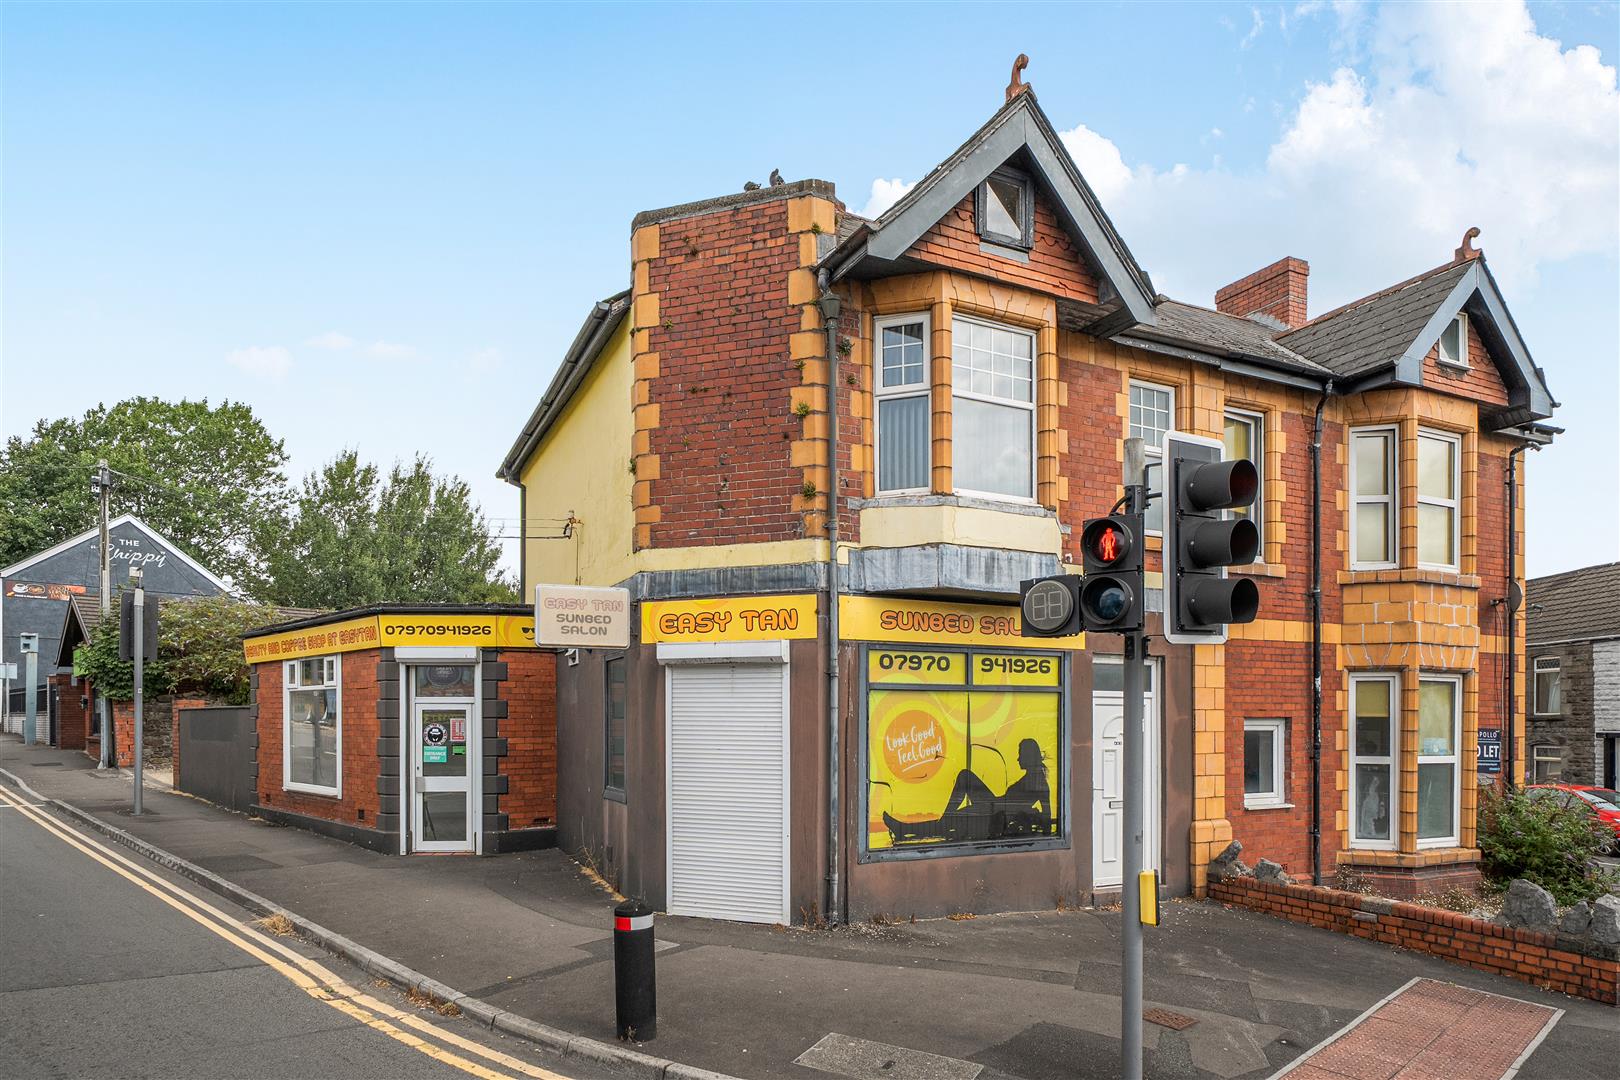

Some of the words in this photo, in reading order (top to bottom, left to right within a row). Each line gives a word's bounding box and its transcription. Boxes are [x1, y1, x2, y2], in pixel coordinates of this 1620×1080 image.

[544, 597, 588, 611] EASY
[591, 599, 625, 613] TAN
[556, 613, 612, 625] SUNBED
[659, 611, 732, 634] EASY
[740, 608, 799, 632] TAN
[880, 610, 974, 634] SUNBED
[979, 615, 1022, 636] SAL
[268, 641, 280, 655] AND
[280, 637, 307, 654] COFFEE
[308, 634, 327, 650] SHOP
[328, 631, 338, 646] AT
[339, 625, 377, 645] EASYTAN
[385, 625, 491, 635] 07970941926
[560, 625, 608, 636] SALON
[879, 653, 951, 672] 07970
[980, 657, 1051, 674] 941926
[886, 732, 909, 752] Look
[910, 720, 935, 744] Good
[897, 744, 918, 765] Feel
[918, 735, 942, 759] Good
[1484, 745, 1499, 758] LET
